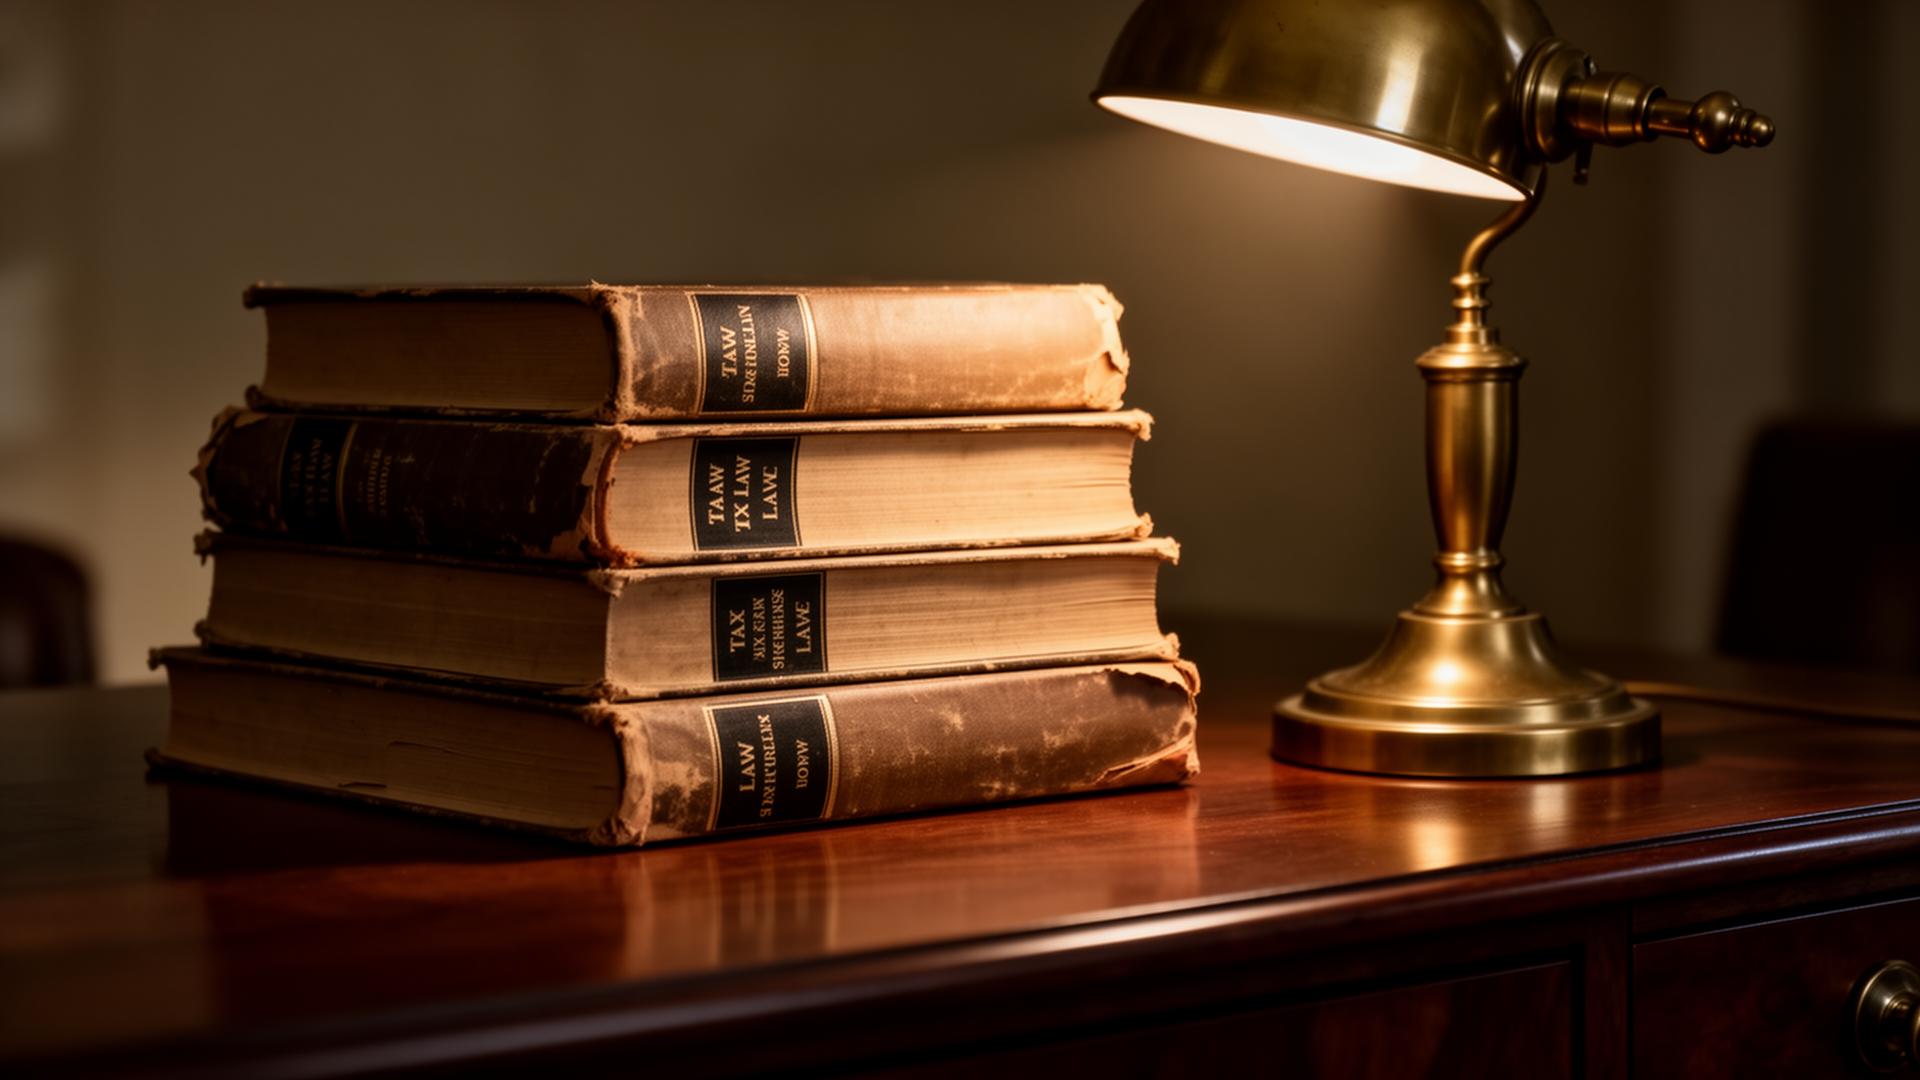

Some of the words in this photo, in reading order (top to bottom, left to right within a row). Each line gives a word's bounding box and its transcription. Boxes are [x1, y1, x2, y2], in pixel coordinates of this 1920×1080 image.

[720, 325, 737, 379] TAW
[708, 463, 725, 525] TAAW
[733, 454, 751, 498] LAW
[733, 502, 751, 533] TX
[729, 608, 746, 653] TAX
[737, 741, 756, 792] LAW
